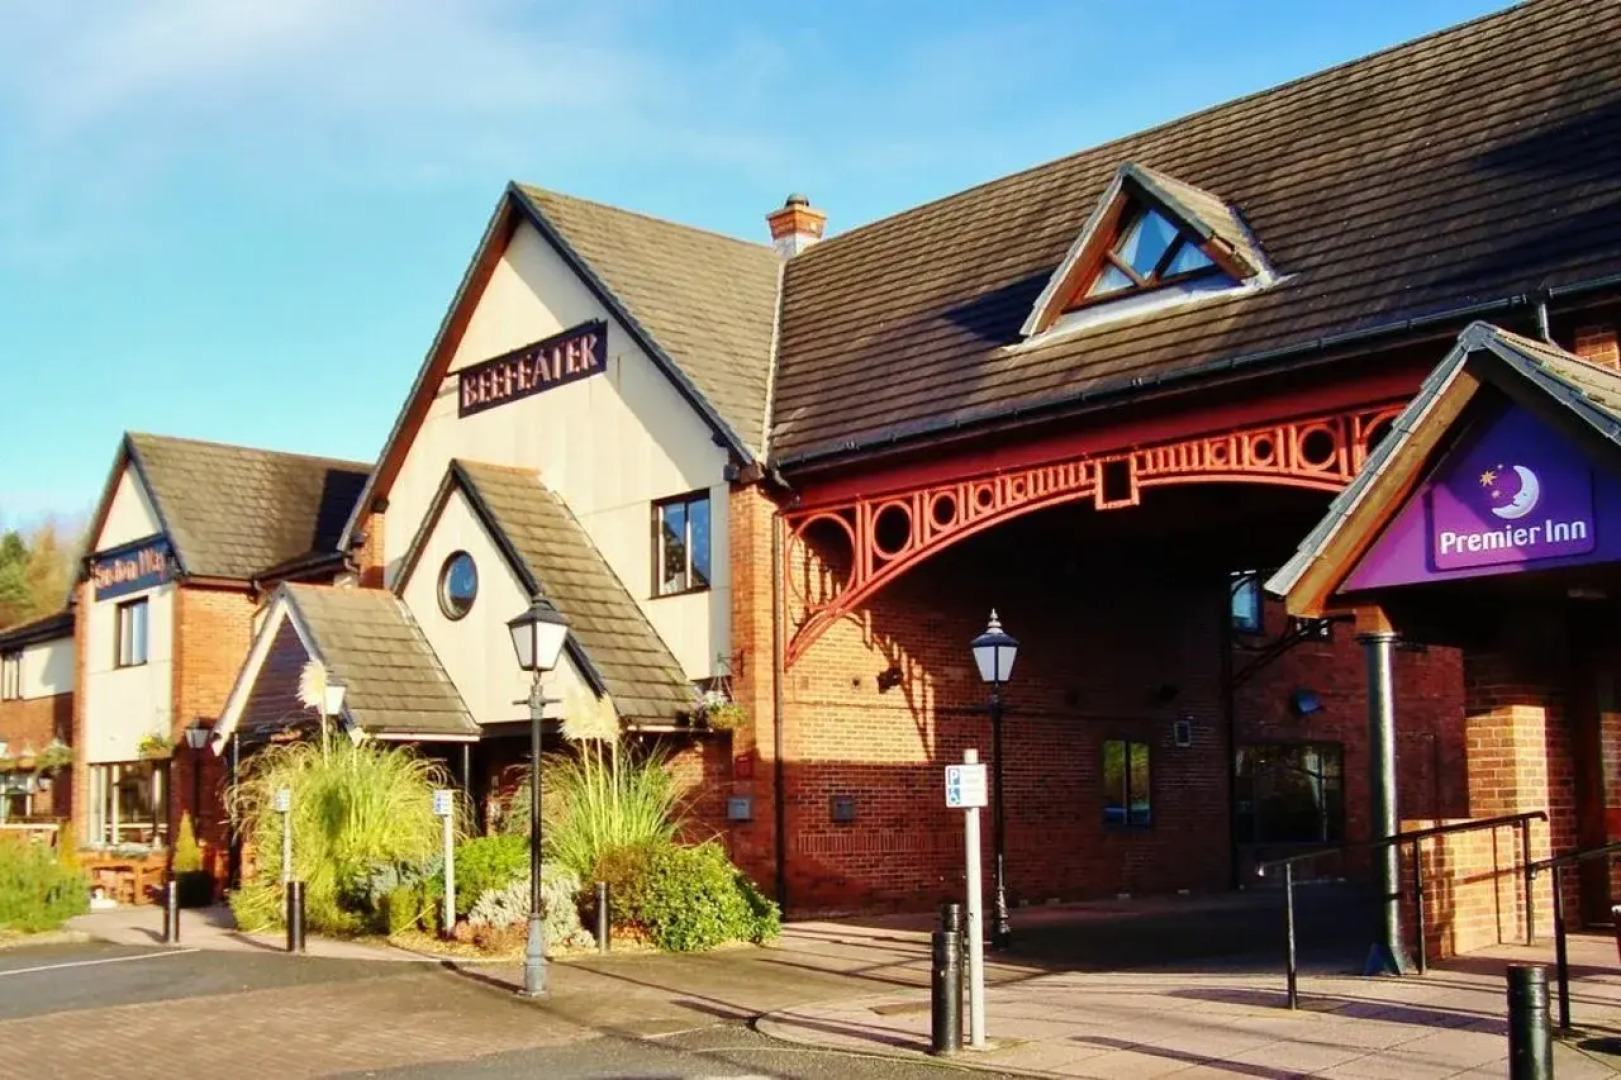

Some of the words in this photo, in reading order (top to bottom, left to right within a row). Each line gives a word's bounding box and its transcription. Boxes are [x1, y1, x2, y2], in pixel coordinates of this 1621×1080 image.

[463, 333, 598, 408] BEEFEATER
[1440, 525, 1541, 555] Premier
[1545, 519, 1587, 543] Inn
